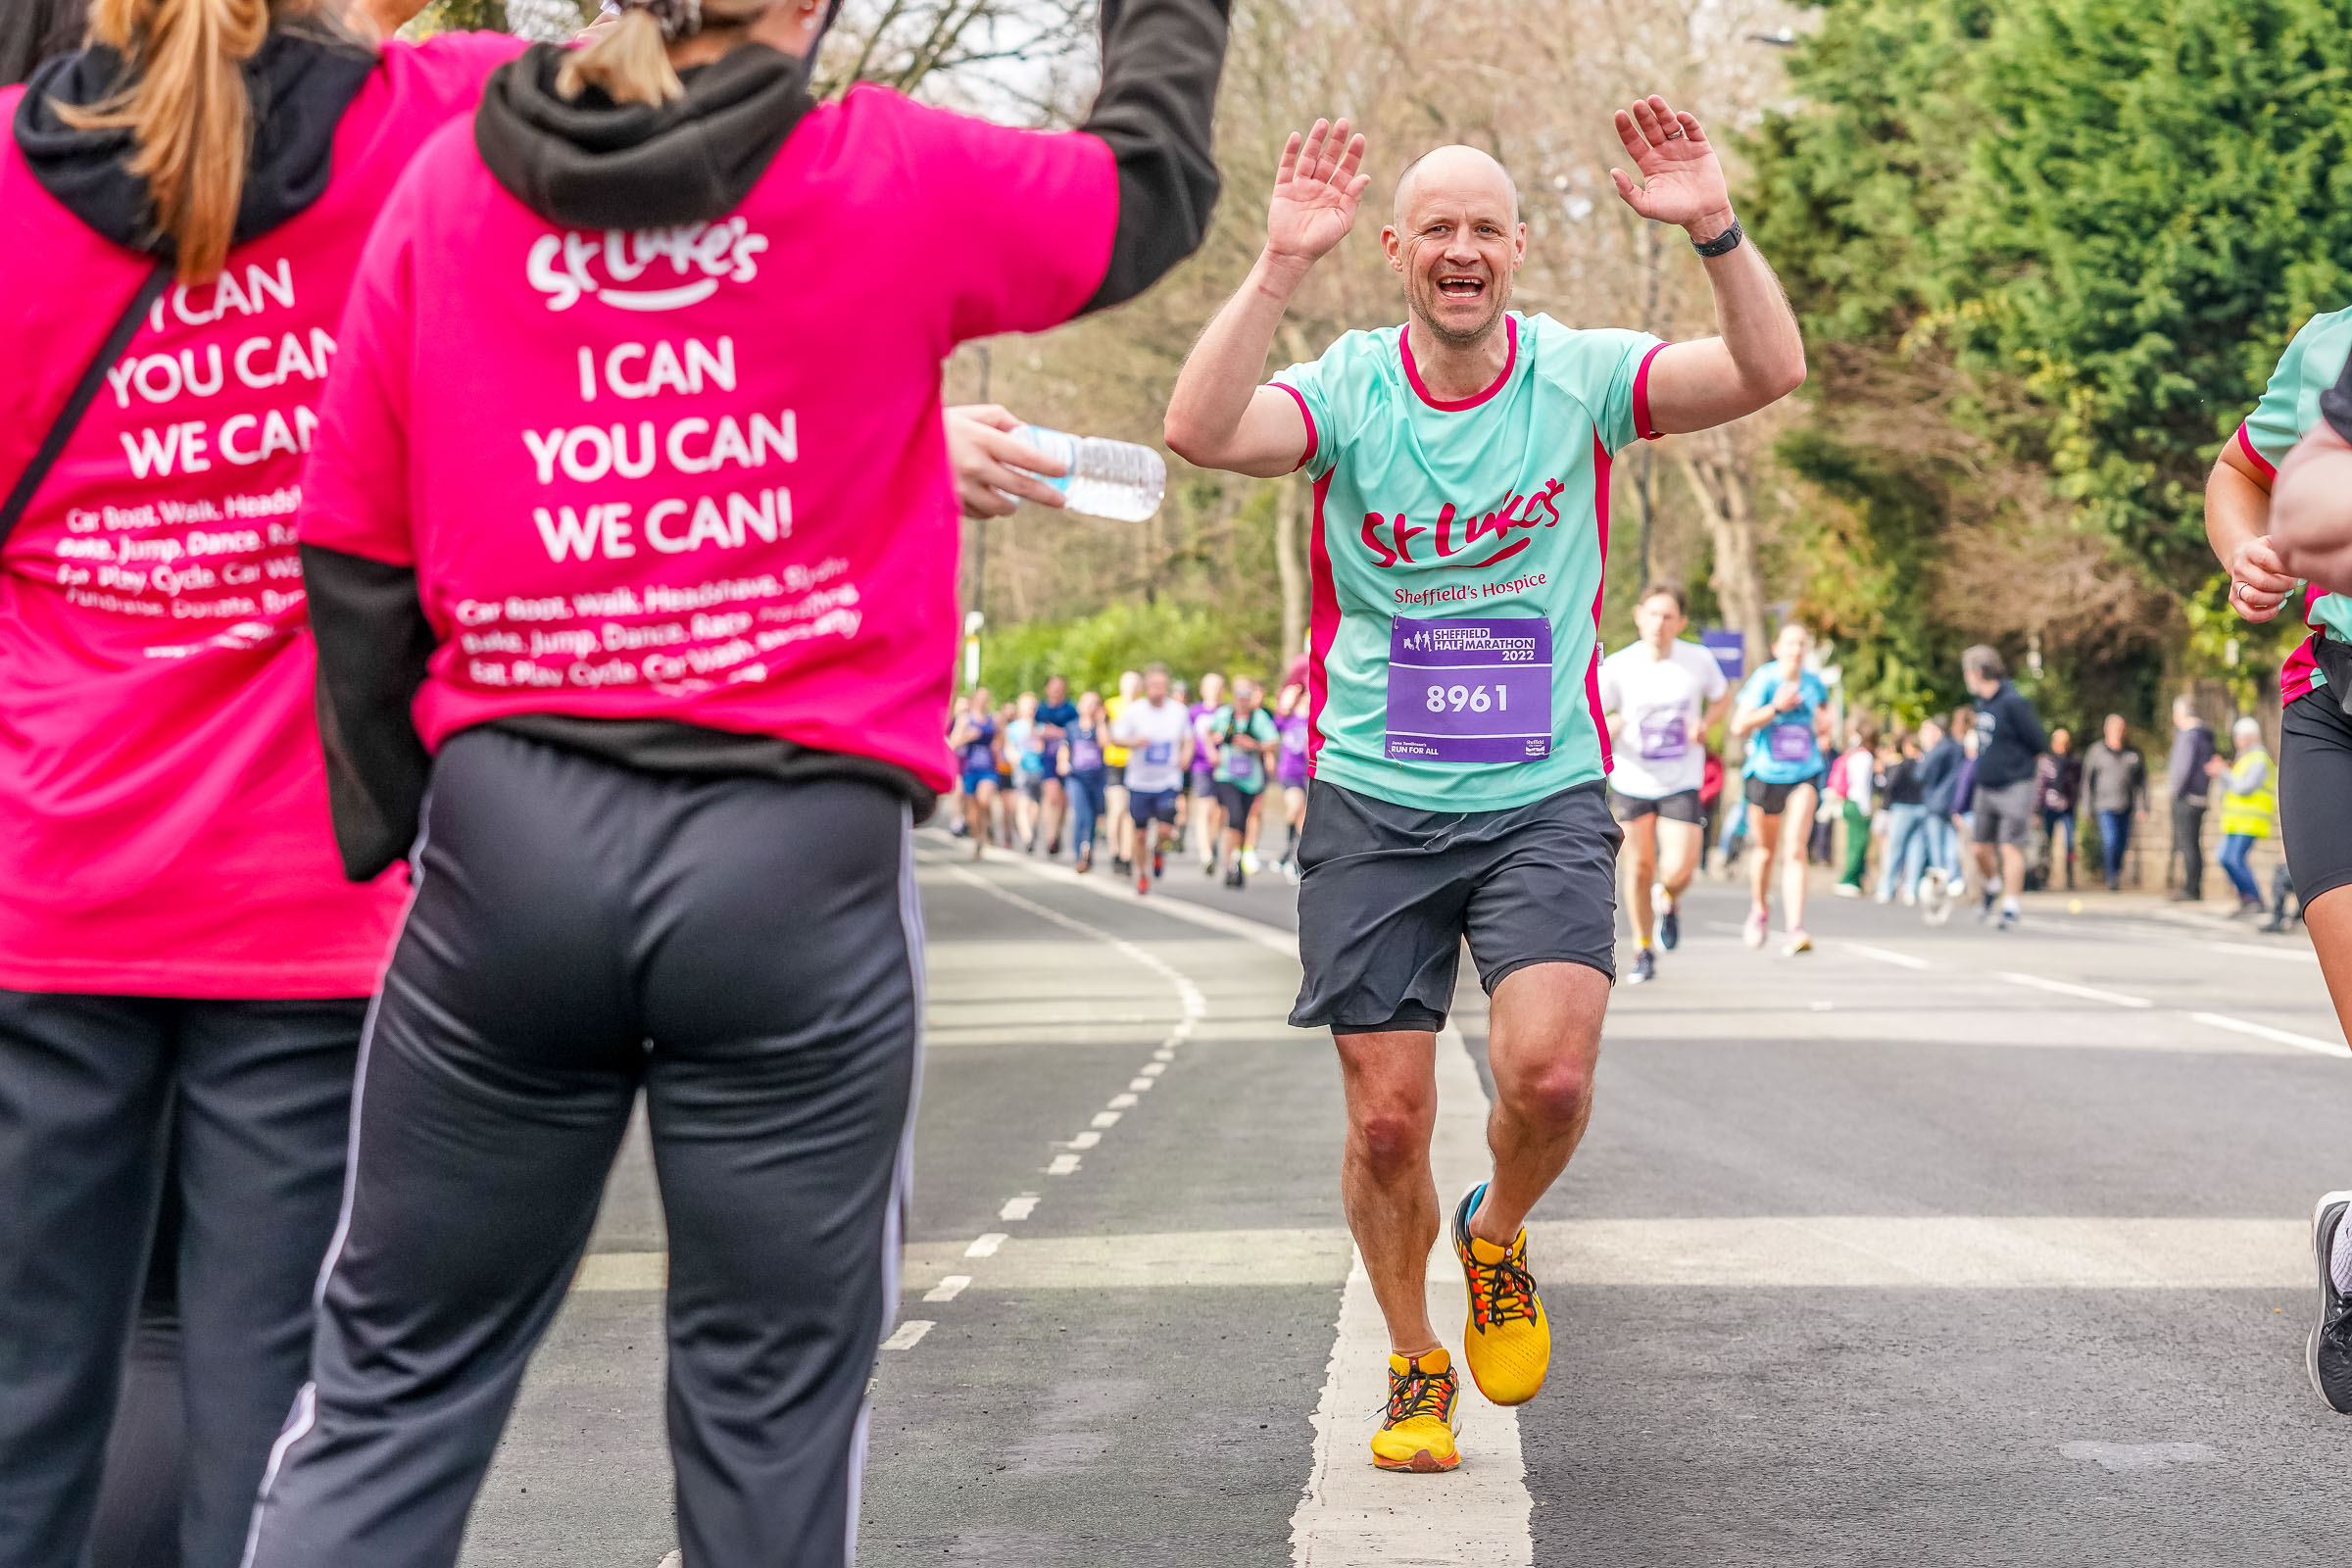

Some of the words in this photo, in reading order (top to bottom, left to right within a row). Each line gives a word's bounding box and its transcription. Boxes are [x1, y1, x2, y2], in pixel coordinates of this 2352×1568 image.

[172, 258, 296, 326] CAN
[107, 343, 223, 409] YOU
[577, 345, 597, 402] I
[605, 335, 737, 399] CAN
[120, 420, 211, 479] WE
[521, 419, 656, 484] YOU
[665, 409, 799, 474] CAN
[532, 502, 636, 563] WE
[644, 486, 793, 553] CAN!
[1394, 585, 1478, 606] Sheffield's
[1483, 573, 1547, 598] Hospice
[1434, 640, 1463, 651] HALF
[1464, 638, 1535, 650] MARATHON
[1435, 628, 1489, 640] SHEFFIELD
[1501, 650, 1535, 662] 2022
[1426, 684, 1507, 713] 8961
